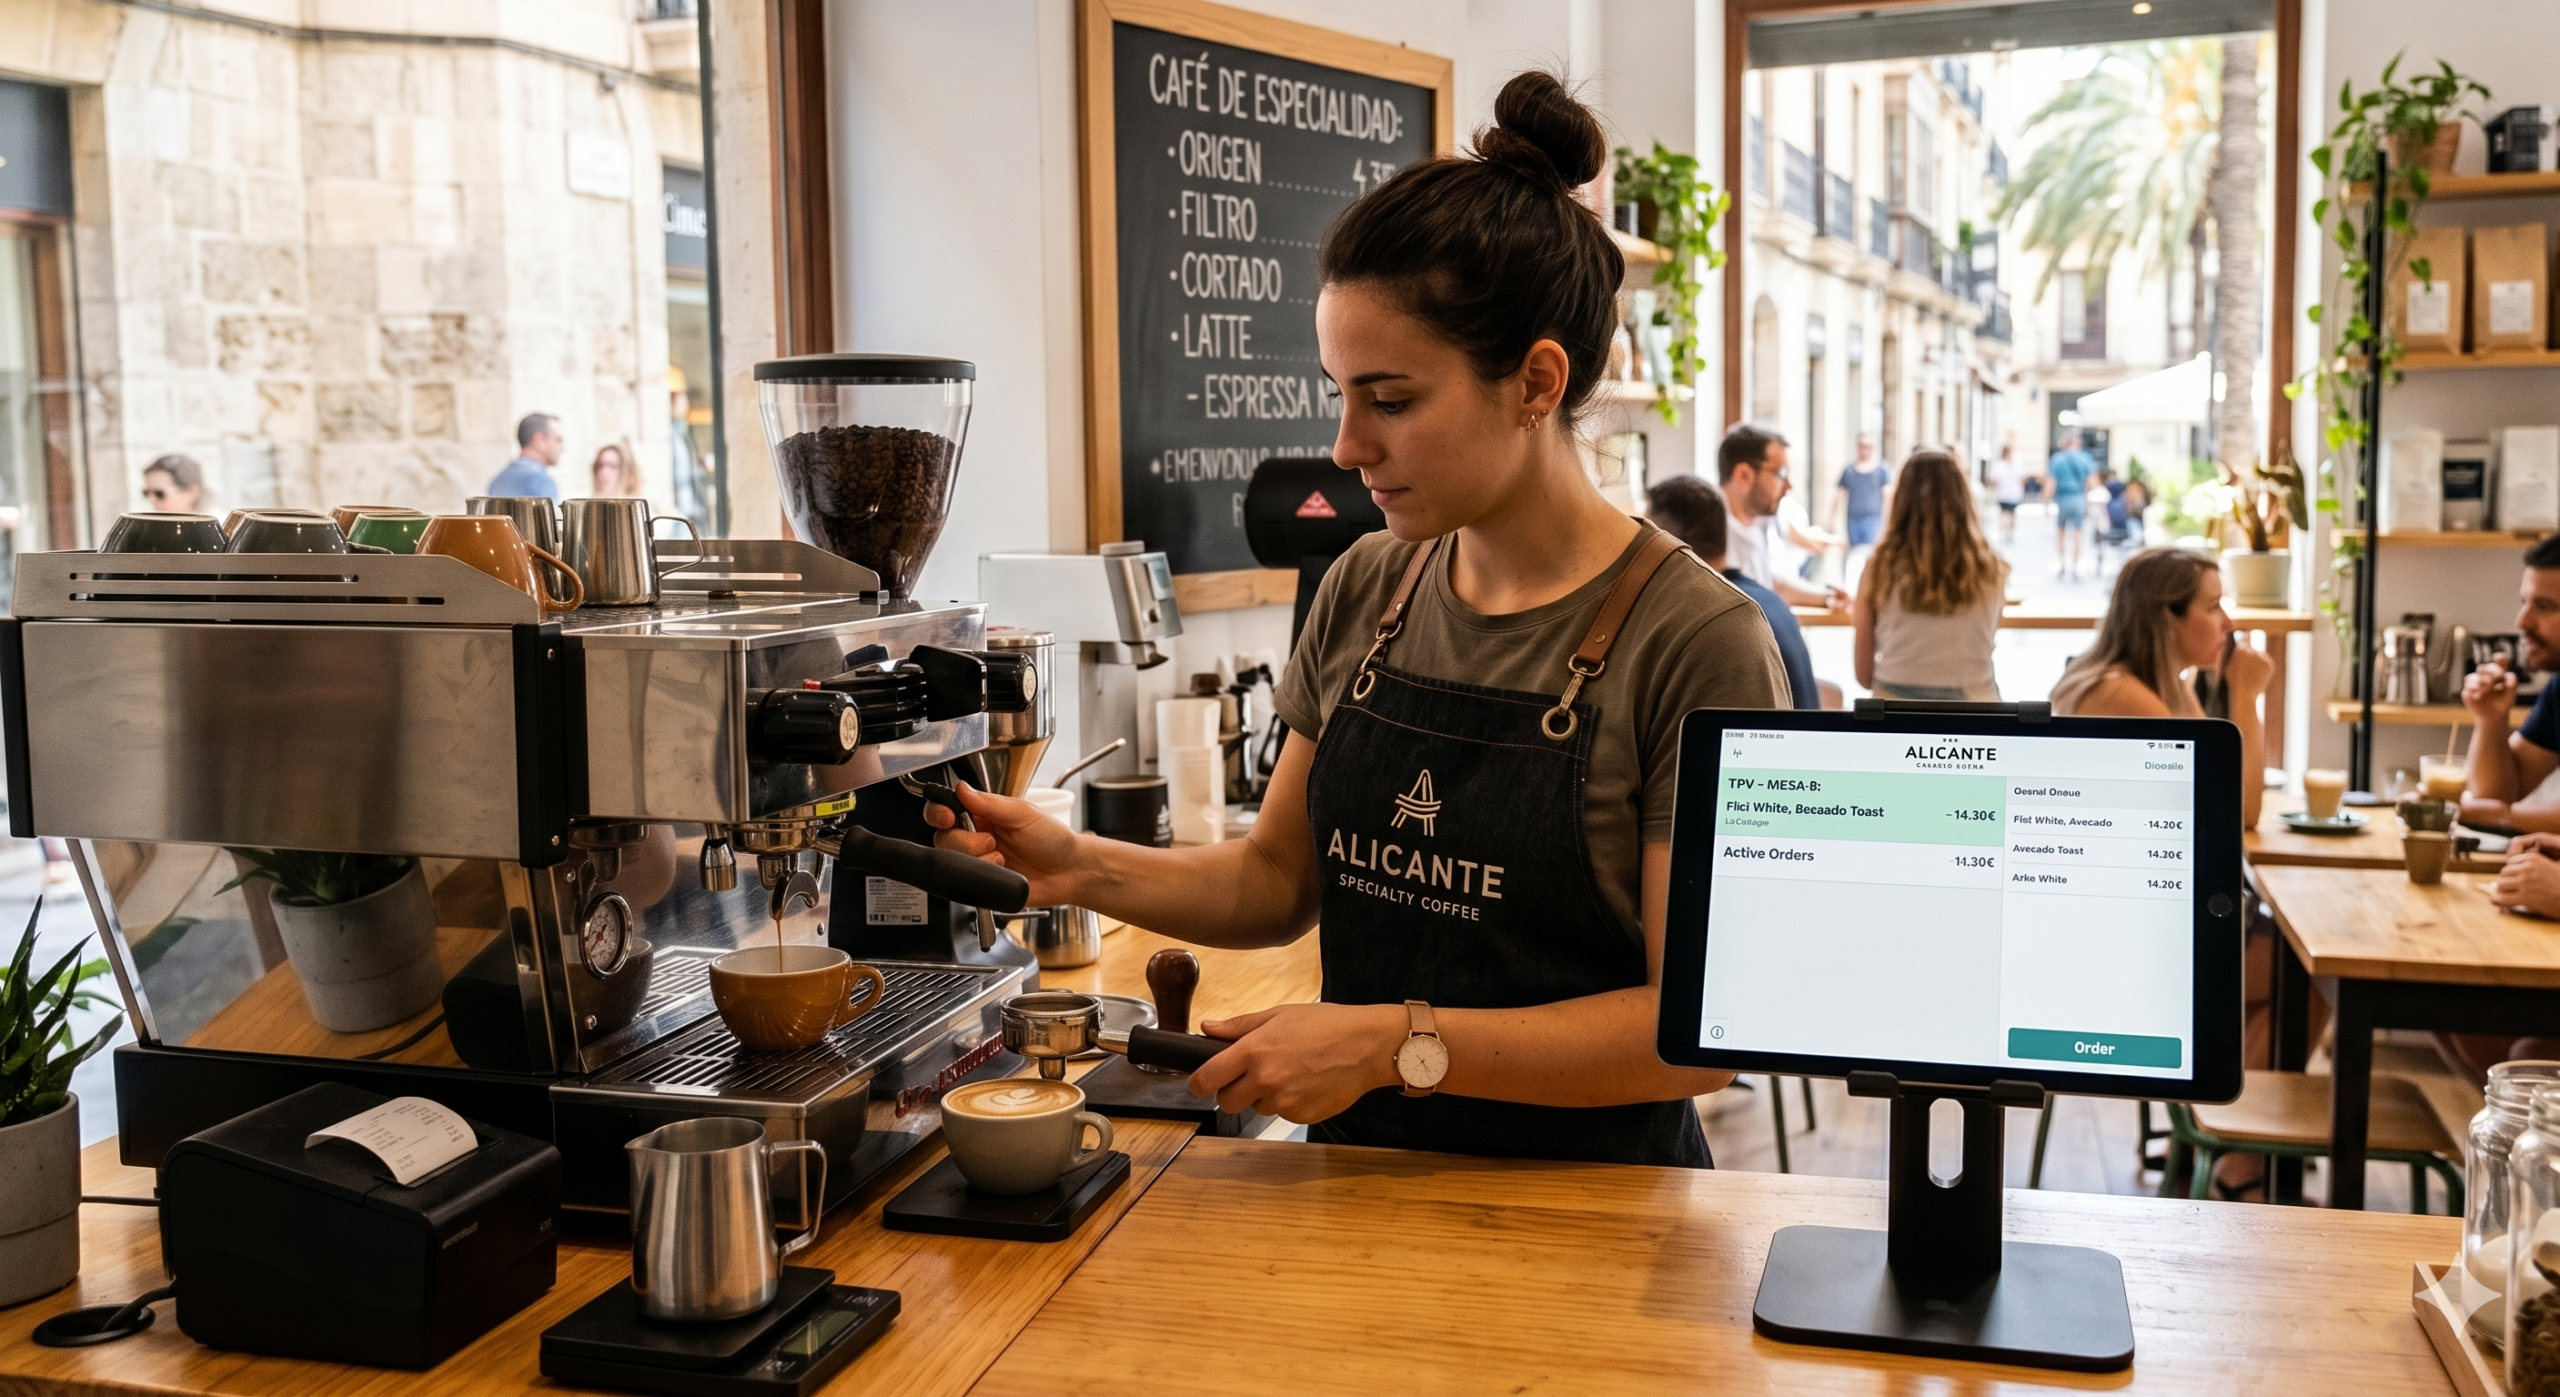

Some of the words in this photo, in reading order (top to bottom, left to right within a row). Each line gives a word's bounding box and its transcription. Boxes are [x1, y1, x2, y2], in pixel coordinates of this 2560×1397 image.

[1150, 52, 1211, 113] CAFÉ
[1218, 67, 1248, 119] DE
[1254, 74, 1404, 145] ESPECIALIDAD:
[1179, 130, 1262, 185] ORIGEN
[1180, 190, 1258, 243] FILTRO
[1181, 251, 1283, 303] CORTADO
[1184, 313, 1254, 360] LATTE
[1204, 374, 1312, 420] ESPRESSA
[1904, 746, 1997, 761] ALICANTE
[1728, 778, 1755, 790] TPV
[1767, 779, 1822, 792] MESA-B:
[1753, 802, 1792, 816] White,
[1850, 806, 1885, 818] Toast
[2035, 816, 2067, 826] White,
[1327, 828, 1505, 899] ALICANTE
[1723, 846, 1766, 859] Active
[1769, 848, 1815, 861] Orders
[2013, 844, 2055, 854] Avecado
[2058, 846, 2084, 855] Toast
[2038, 875, 2068, 884] White
[1339, 873, 1415, 905] SPECIALTY
[1421, 897, 1480, 921] COFFEE
[2074, 1041, 2115, 1055] Order
